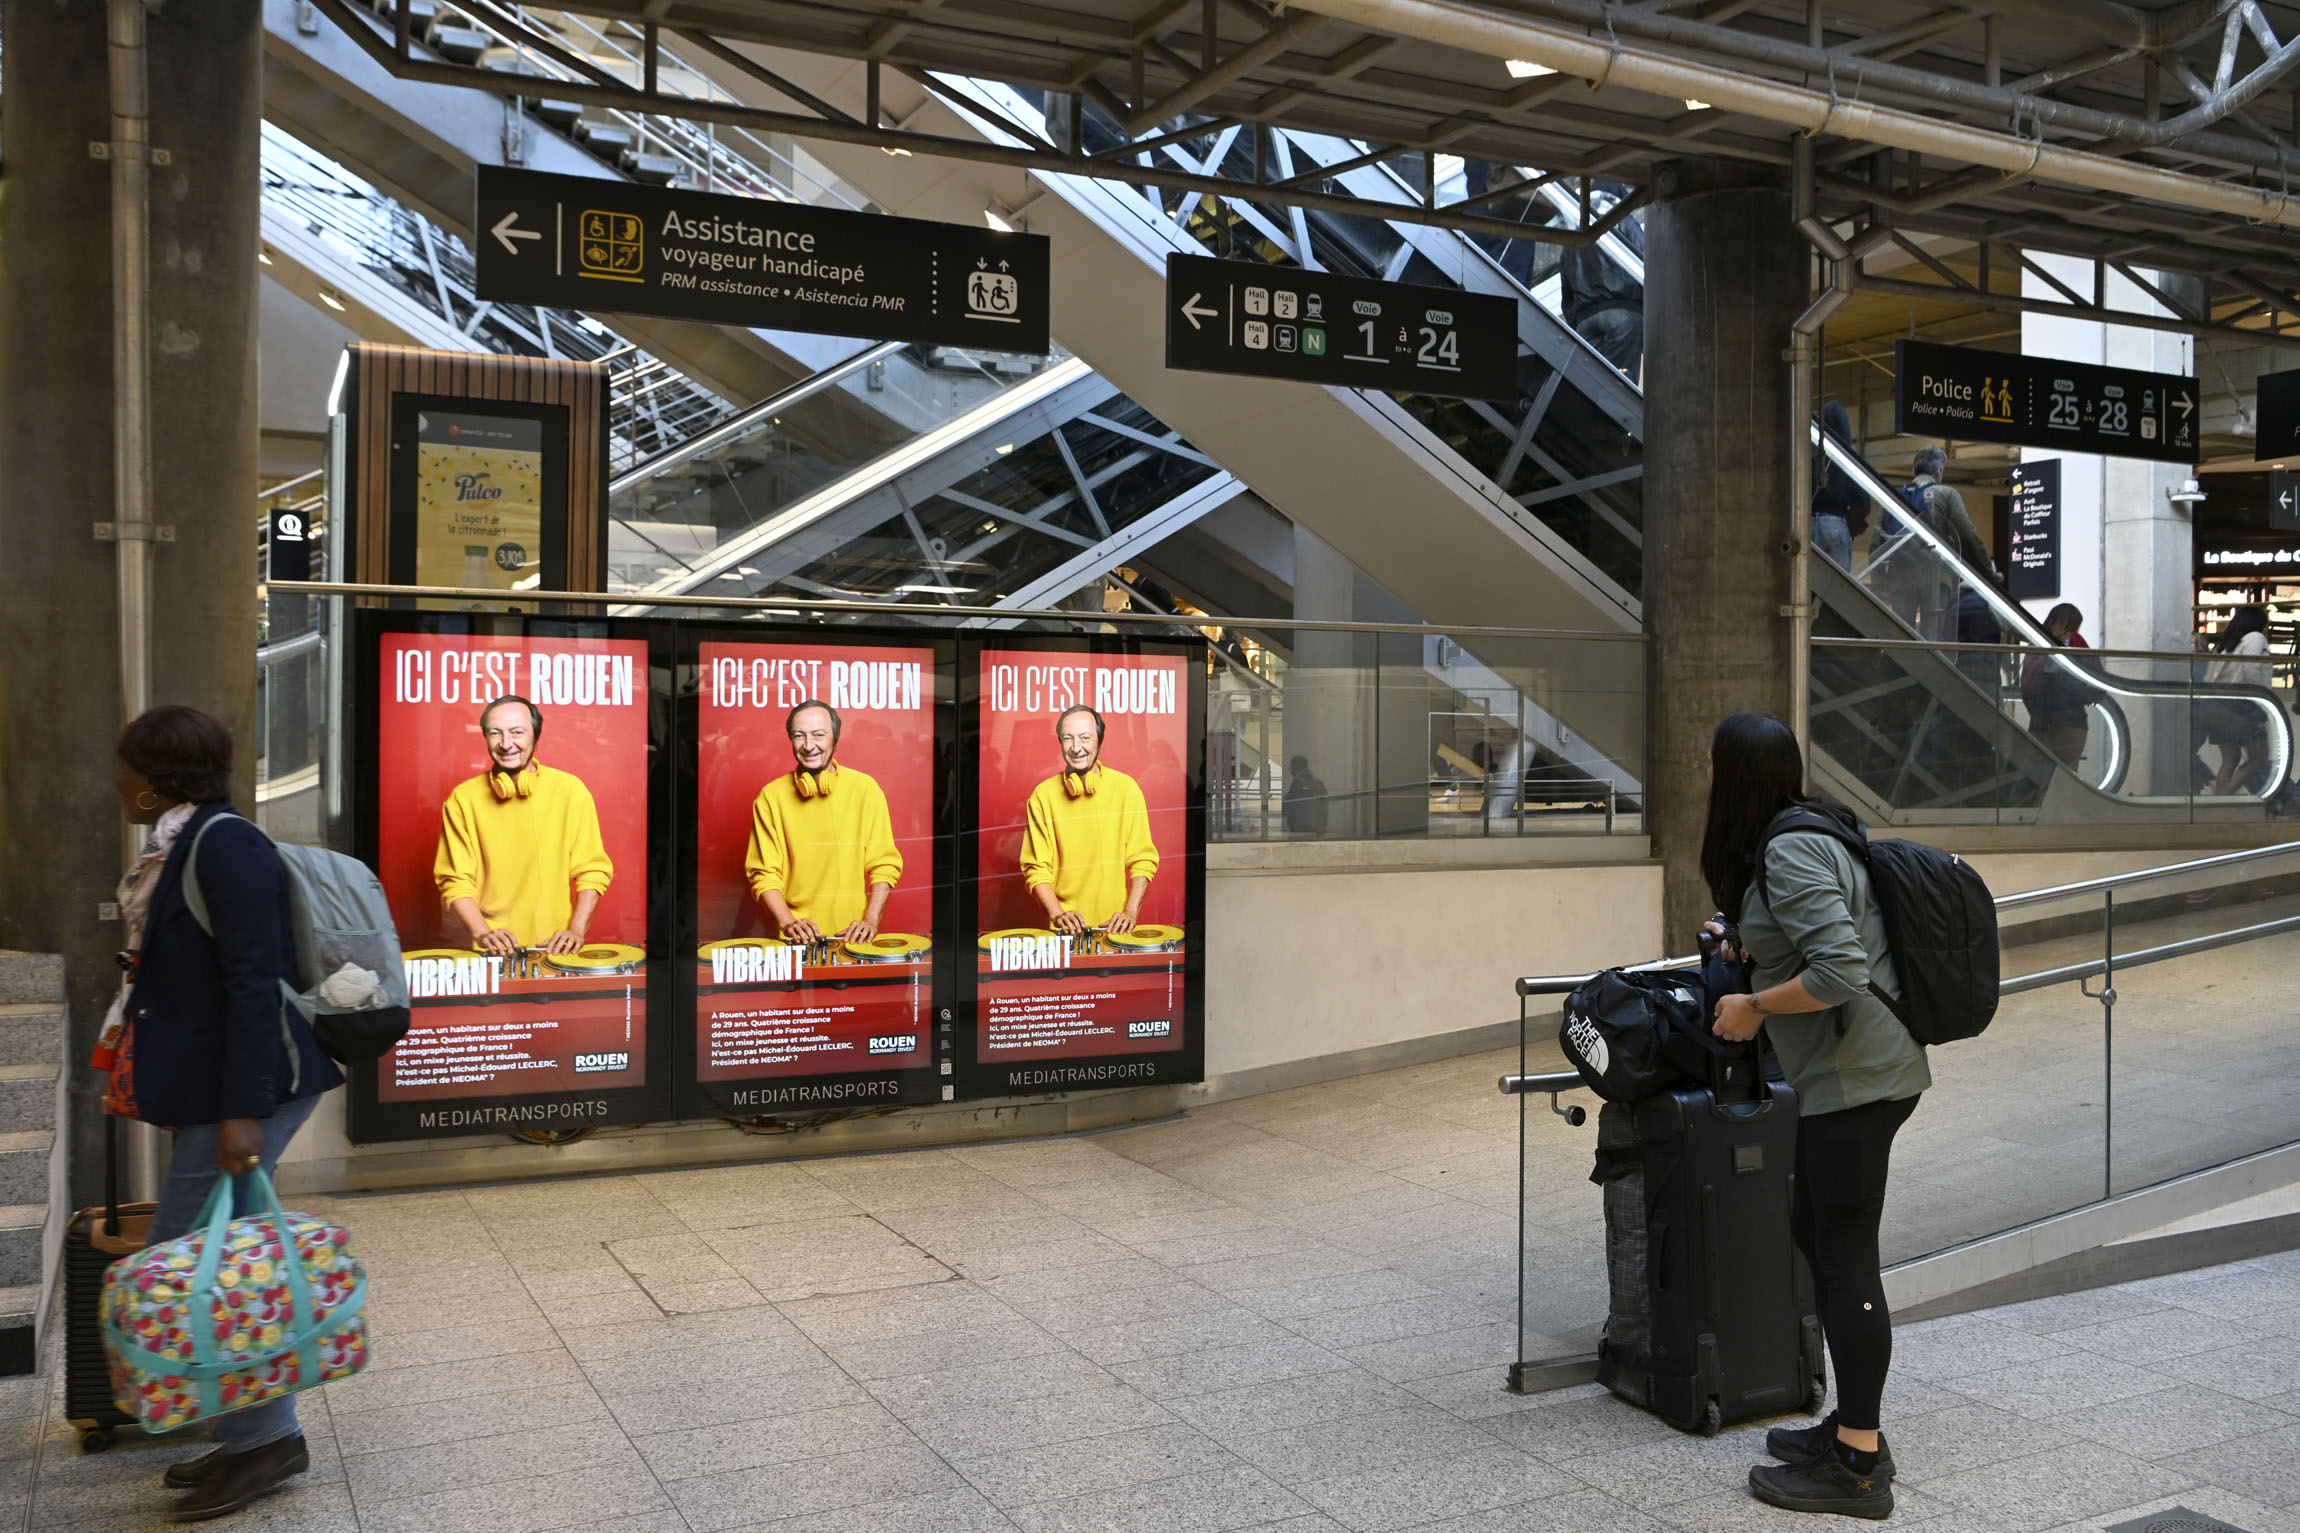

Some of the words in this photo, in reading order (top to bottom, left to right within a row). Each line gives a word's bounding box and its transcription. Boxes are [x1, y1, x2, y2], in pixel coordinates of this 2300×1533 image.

[661, 210, 816, 252] Assistance
[661, 246, 757, 272] voyageur
[762, 253, 865, 285] handicapé
[661, 272, 697, 289] PRM
[700, 279, 780, 298] assistance
[794, 287, 868, 308] Asistencia
[871, 295, 905, 311] PMR
[1248, 290, 1265, 299] Hall
[1278, 293, 1294, 303] Hall
[1253, 300, 1259, 312] 1
[1282, 304, 1289, 315] 2
[1356, 302, 1378, 314] Voie
[1429, 311, 1450, 323] Voie
[1248, 323, 1265, 333] Hall
[1252, 334, 1260, 346] 4
[1308, 333, 1320, 350] N
[1358, 320, 1374, 356] 1
[1399, 326, 1407, 342] à
[1417, 327, 1459, 366] 24
[1922, 375, 1972, 400] Police
[1912, 402, 1938, 415] Police
[1945, 406, 1974, 419] Policía
[2049, 394, 2079, 425] 25
[2086, 400, 2092, 412] à
[2099, 400, 2128, 430] 28
[454, 474, 502, 501] Pulco
[455, 512, 488, 525] L'expert
[448, 524, 456, 533] la
[2023, 533, 2048, 541] Starbucks
[2023, 552, 2052, 560] McDonald's
[396, 649, 432, 703] ICI
[441, 650, 521, 704] C'EST
[530, 653, 633, 706] ROUEN
[712, 657, 743, 707] ICI
[751, 658, 822, 708] C'EST
[830, 661, 921, 710] ROUEN
[991, 664, 1018, 712] ICI
[1026, 665, 1088, 713] C'EST
[1095, 668, 1176, 714] ROUEN
[990, 935, 1073, 971] VIBRANT
[711, 945, 806, 983] VIBRANT
[989, 997, 996, 1005] À
[711, 1011, 718, 1019] À
[759, 1009, 791, 1017] habitant
[831, 1005, 855, 1013] moins
[450, 1025, 486, 1033] habitant
[532, 1021, 559, 1029] moins
[750, 1019, 792, 1027] Quatrième
[1129, 1021, 1170, 1033] ROUEN
[1581, 1015, 1600, 1042] THE
[711, 1029, 773, 1038] démographique
[1031, 1029, 1083, 1038] Michel-Édouard
[1084, 1026, 1116, 1035] LECLERC,
[1569, 1009, 1594, 1051] NORTH
[440, 1035, 487, 1044] Quatrième
[487, 1033, 532, 1041] croissance
[755, 1038, 789, 1046] jeunesse
[799, 1034, 831, 1043] réussite.
[869, 1036, 916, 1048] ROUEN
[1567, 1027, 1588, 1059] FACE
[395, 1046, 466, 1056] démographique
[758, 1045, 818, 1054] Michel-Édouard
[818, 1042, 854, 1051] LECLERC,
[446, 1055, 484, 1065] jeunesse
[496, 1052, 532, 1060] réussite.
[576, 1053, 628, 1066] ROUEN
[749, 1057, 760, 1065] de
[450, 1063, 517, 1073] Michel-Édouard
[518, 1060, 558, 1069] LECLERC,
[1009, 1062, 1156, 1086] MEDIATRANSPORTS
[395, 1078, 438, 1086] Président
[438, 1076, 451, 1084] de
[733, 1080, 899, 1106] MEDIATRANSPORTS
[420, 1100, 608, 1128] MEDIATRANSPORTS
